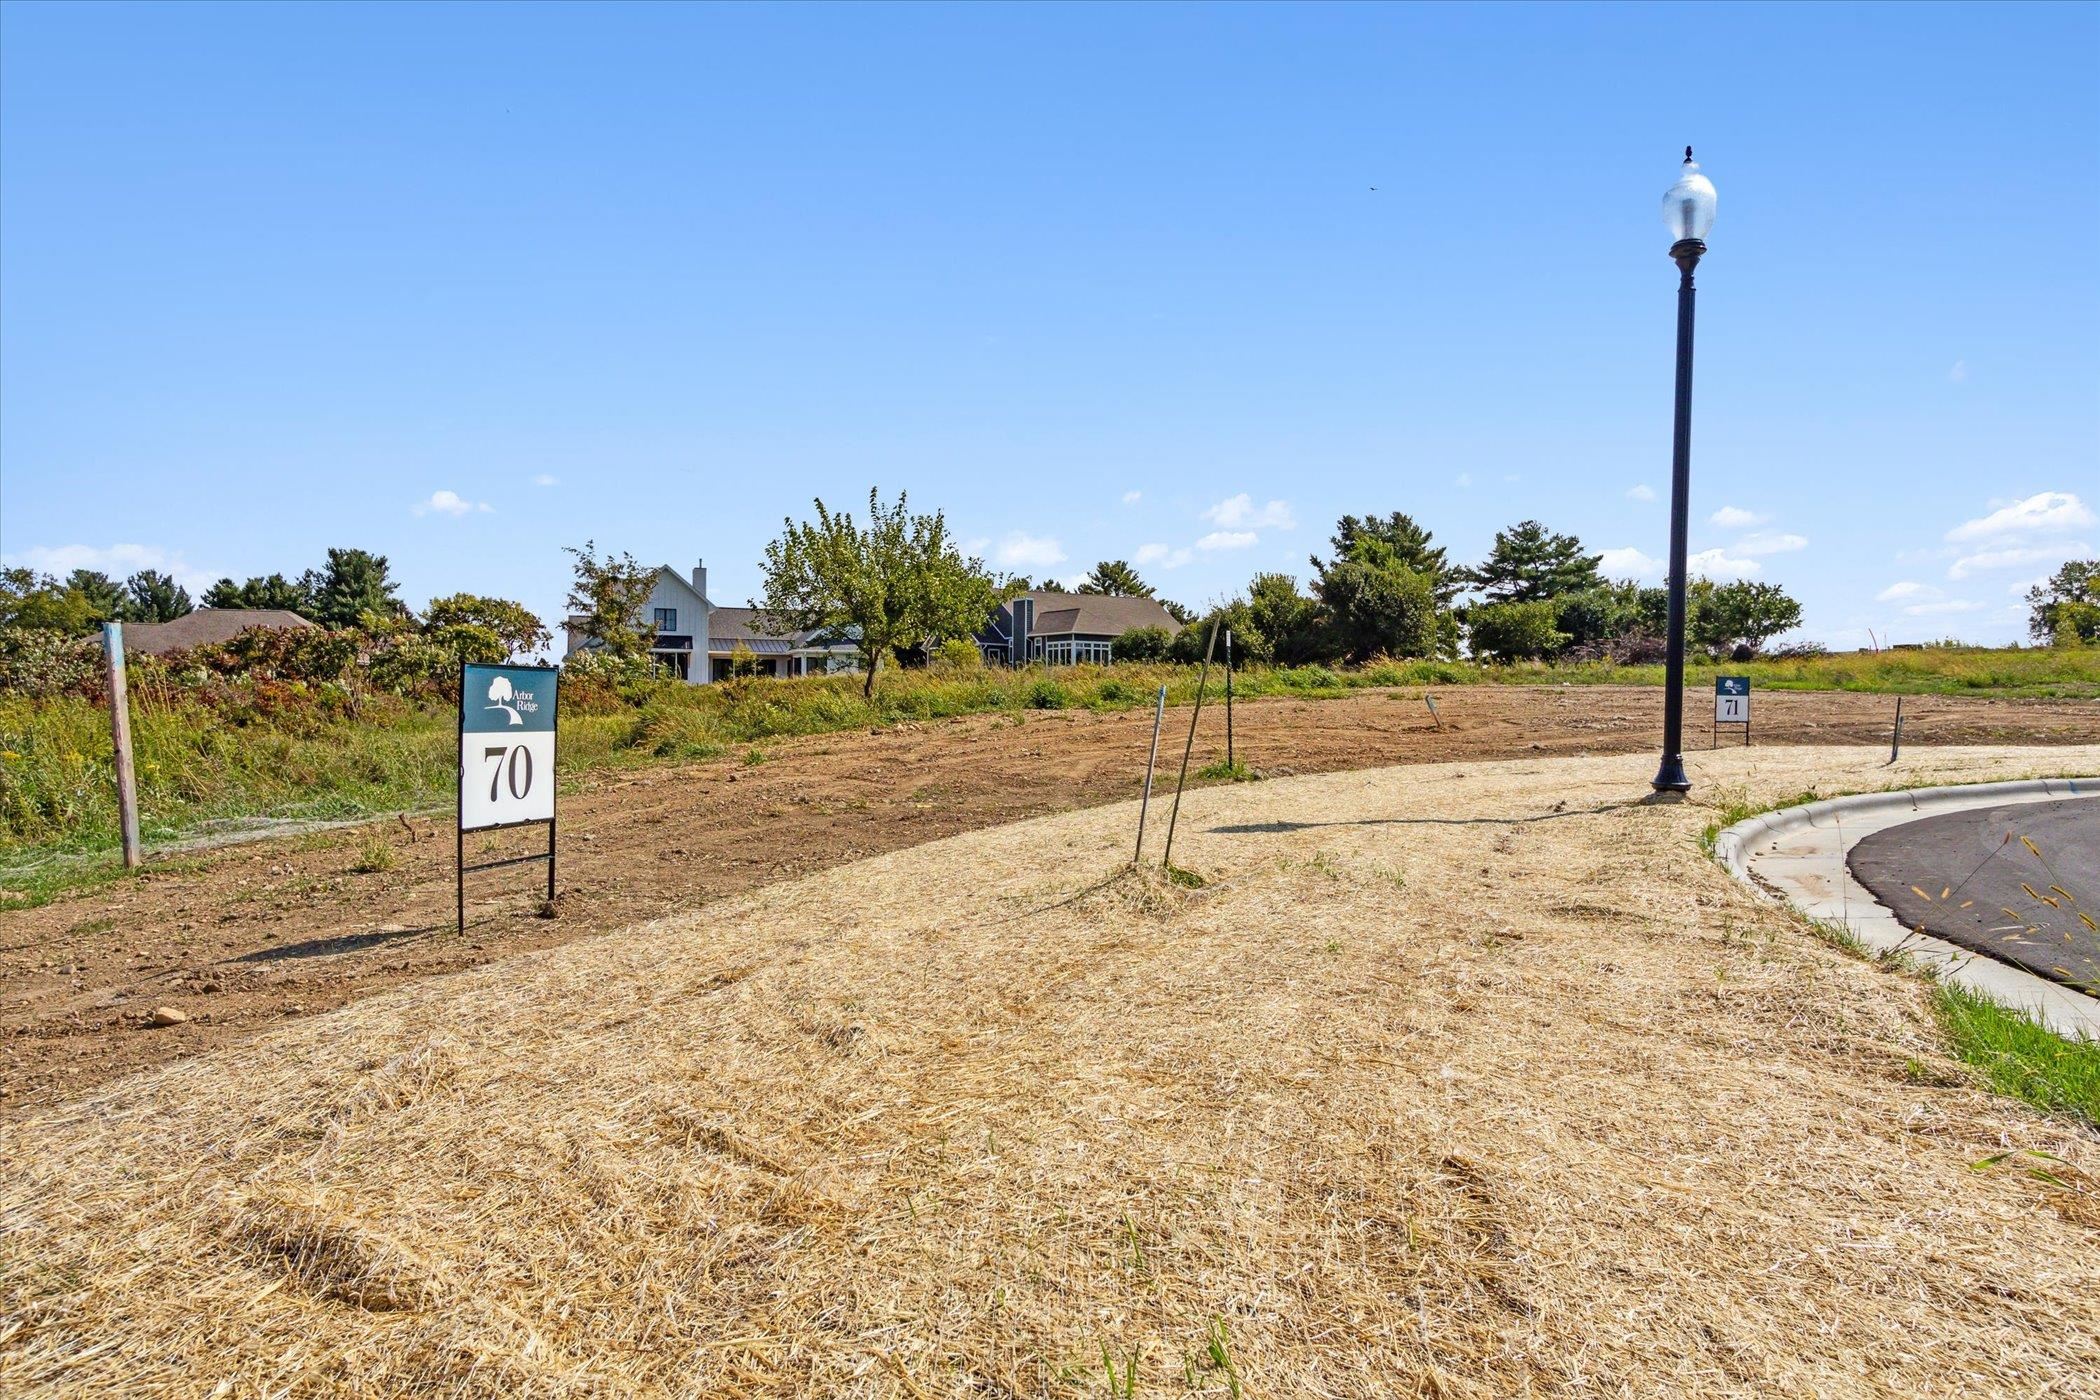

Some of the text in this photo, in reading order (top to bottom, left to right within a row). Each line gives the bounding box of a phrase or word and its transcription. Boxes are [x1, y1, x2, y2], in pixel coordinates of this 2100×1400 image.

[512, 690, 534, 700] Arbor
[516, 700, 538, 712] Ridge
[1725, 699, 1738, 715] 71
[484, 744, 533, 802] 70
